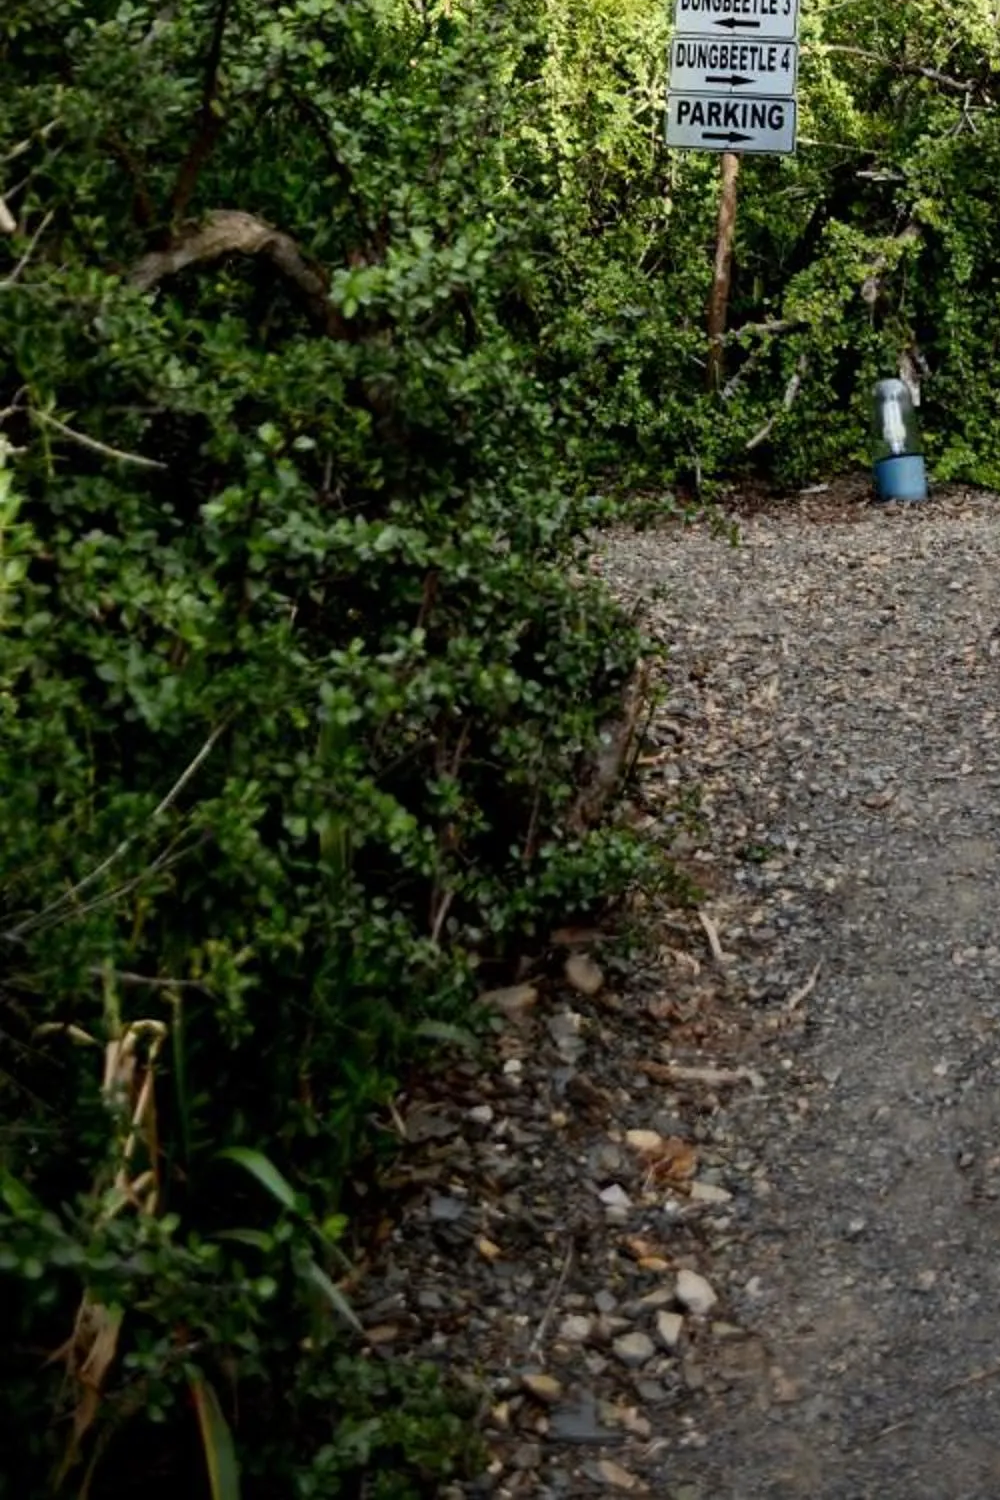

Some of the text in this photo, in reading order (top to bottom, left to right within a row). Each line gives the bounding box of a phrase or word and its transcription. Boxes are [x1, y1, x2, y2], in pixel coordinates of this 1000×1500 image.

[676, 43, 790, 72] DUNGBEETLE 4
[677, 100, 784, 130] PARKING
